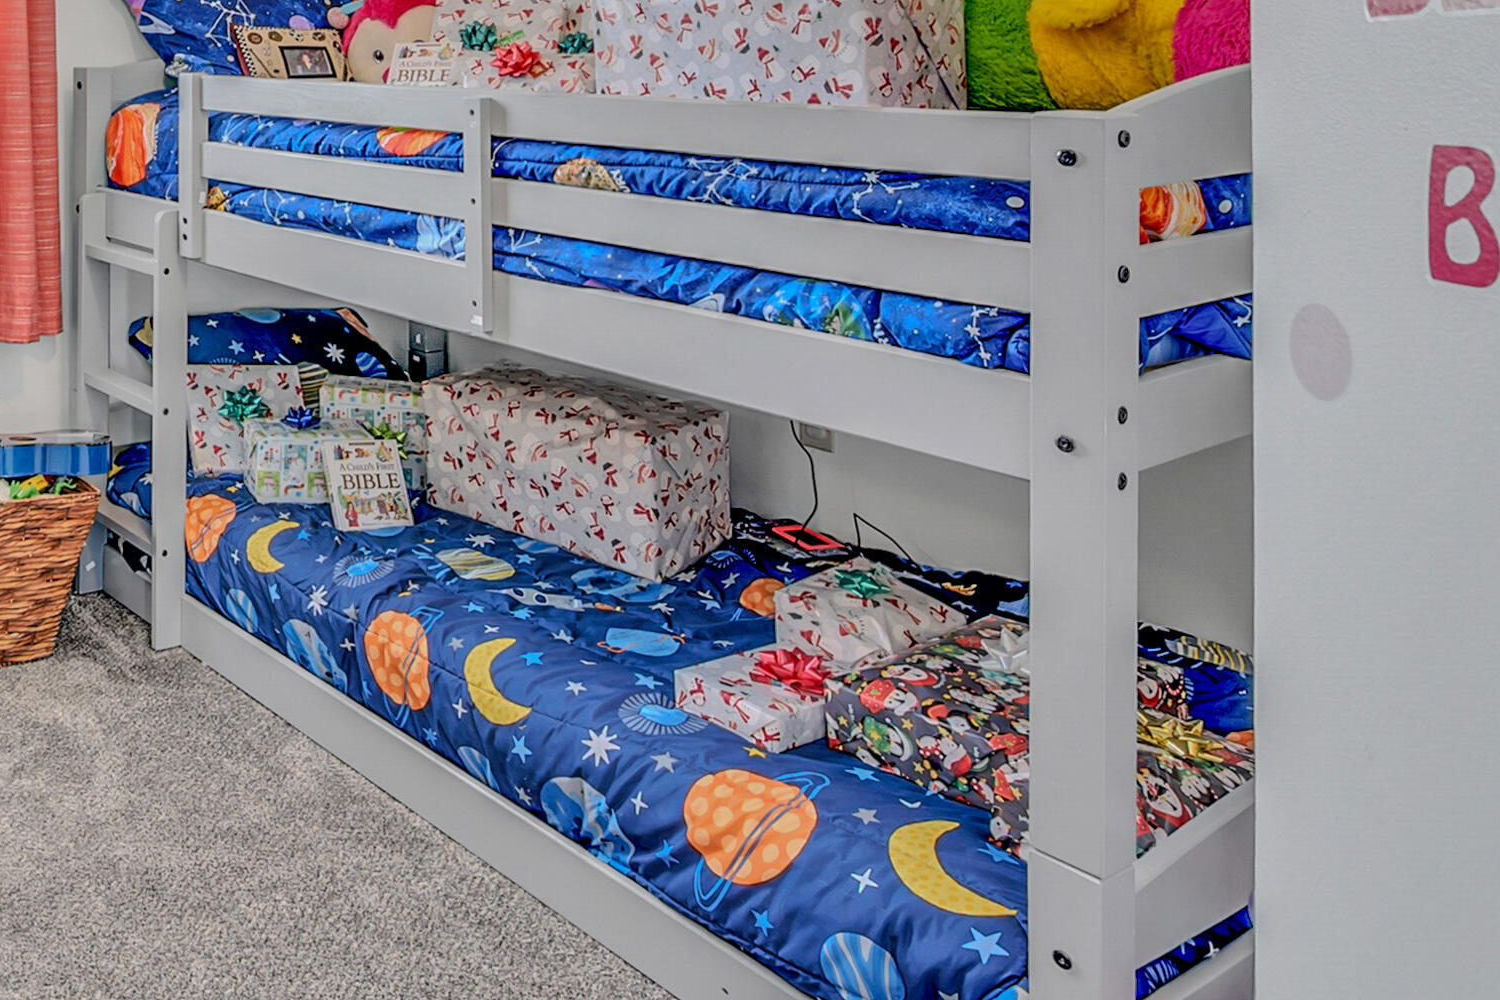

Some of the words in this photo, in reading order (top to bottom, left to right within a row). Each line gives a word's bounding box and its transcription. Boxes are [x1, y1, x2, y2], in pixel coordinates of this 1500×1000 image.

[397, 68, 451, 83] BIBLE
[1429, 144, 1500, 288] B
[341, 472, 401, 490] BIBLE
